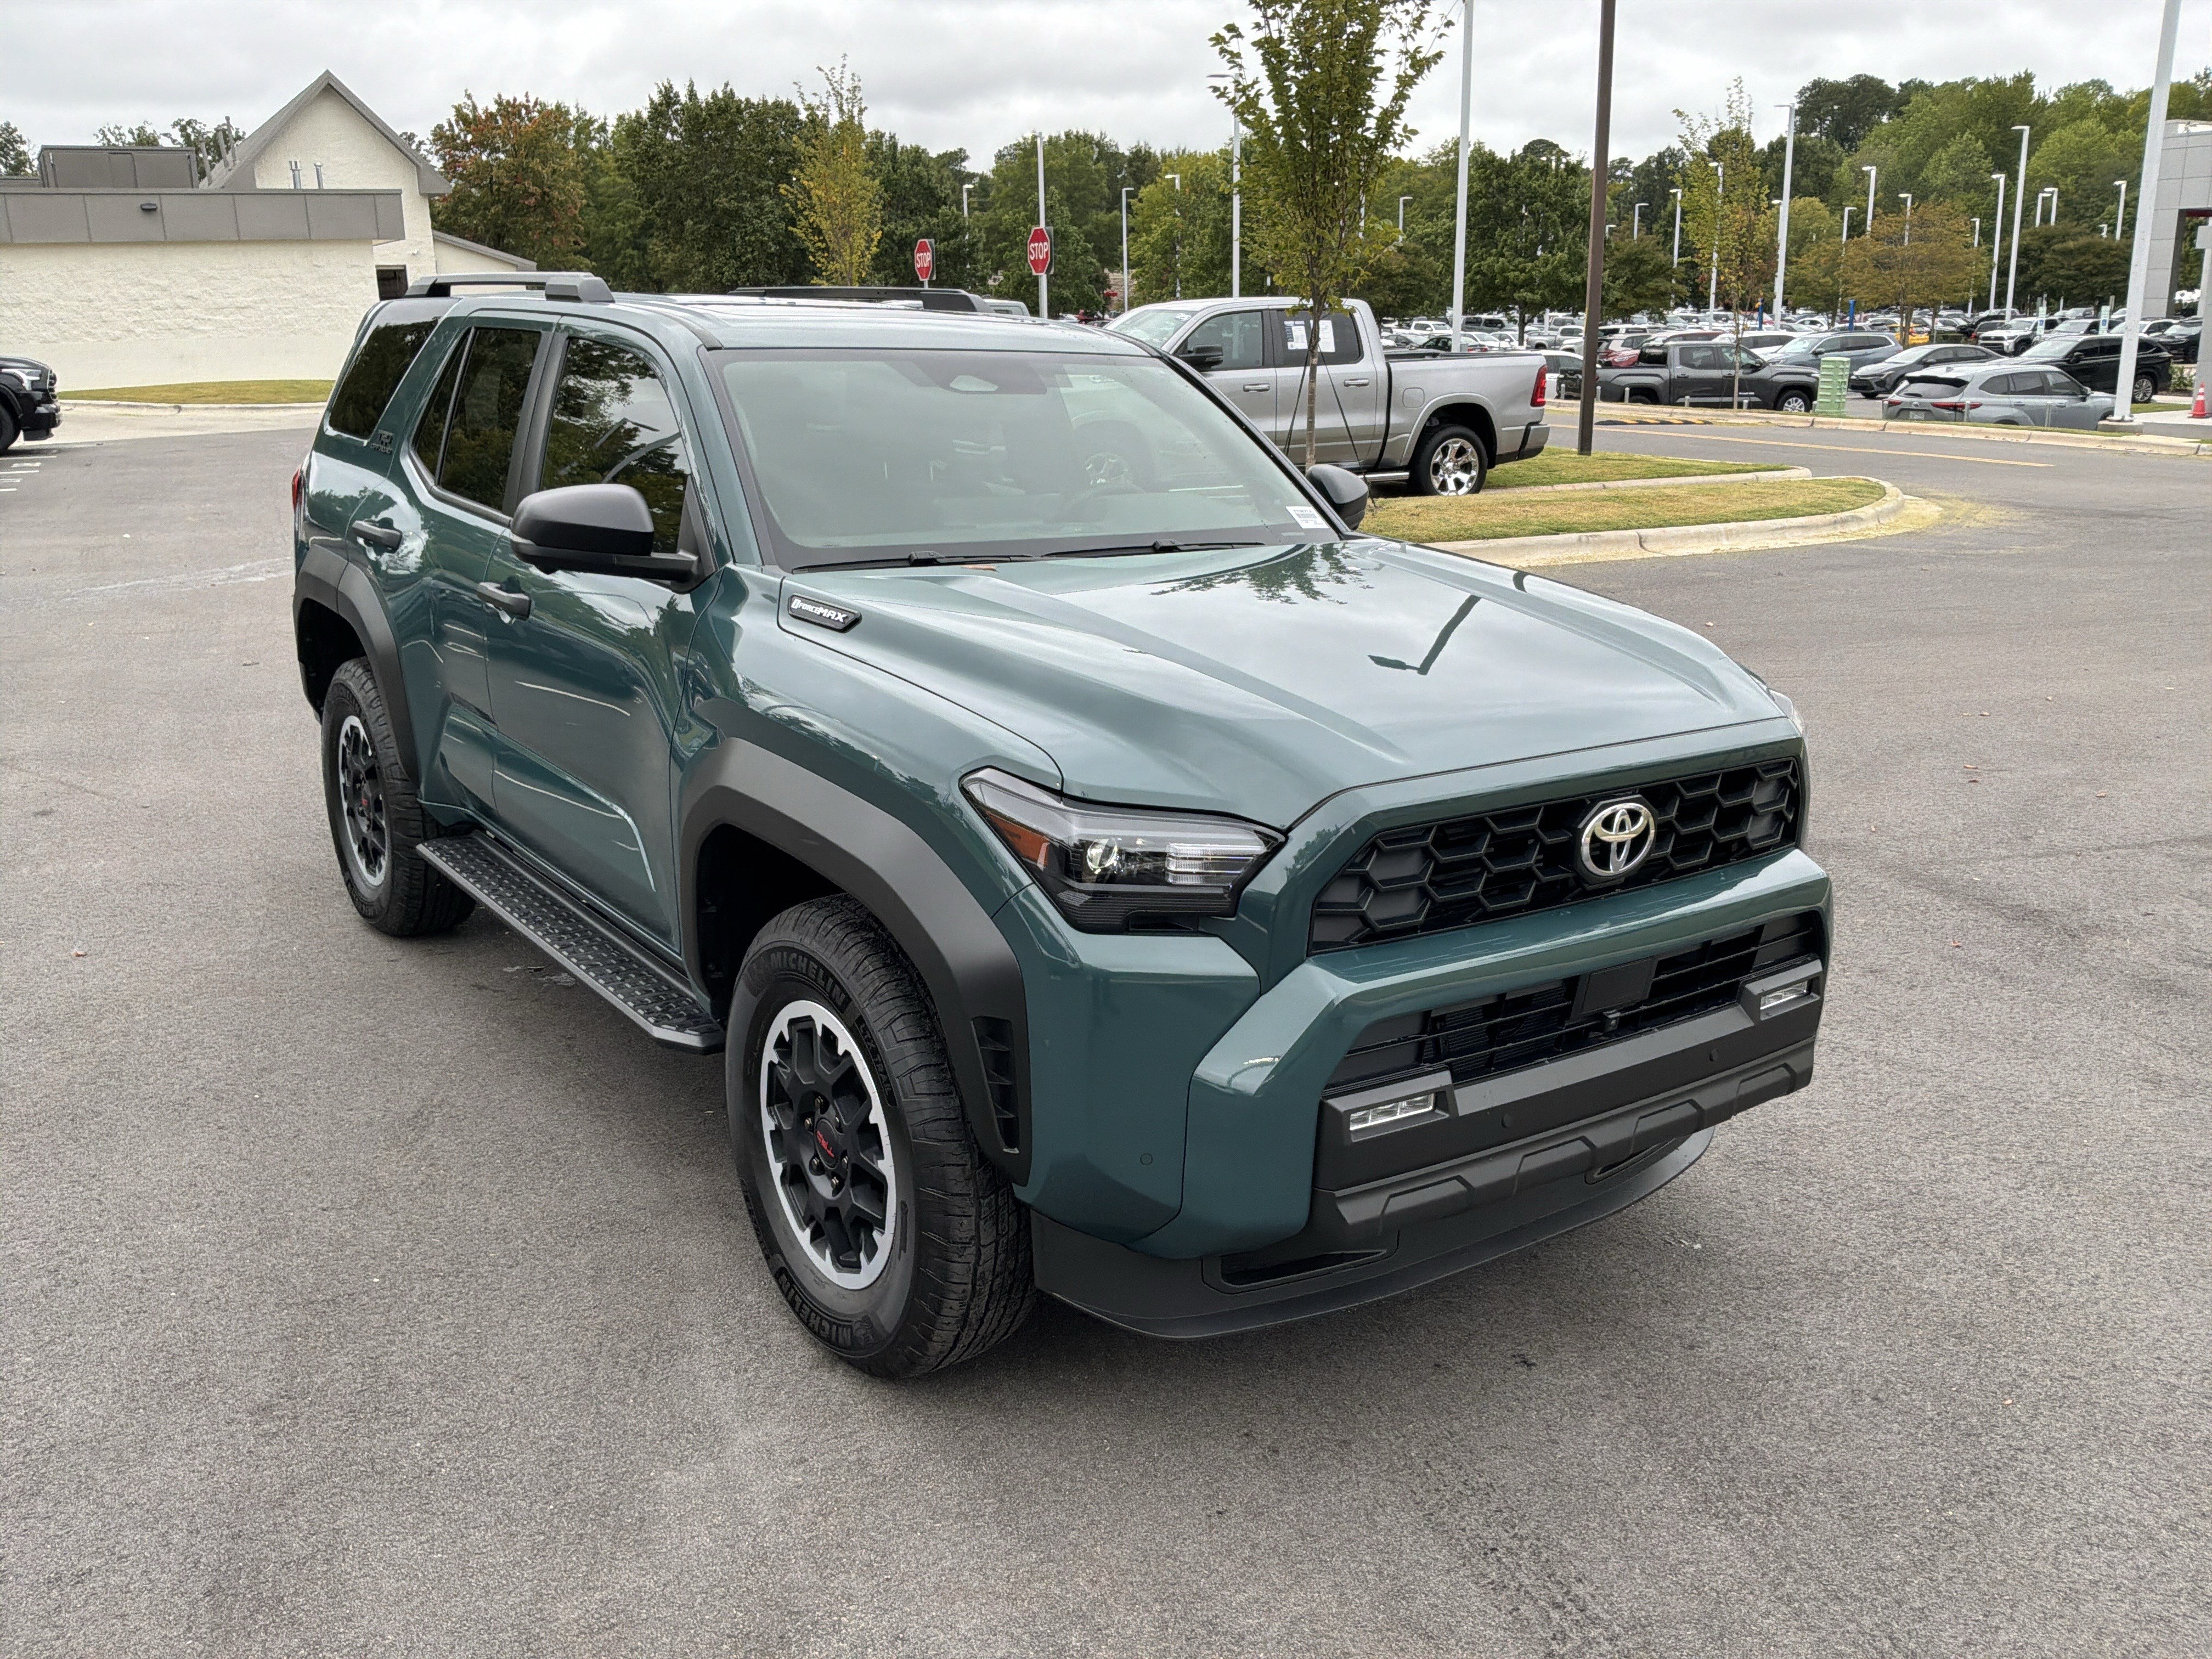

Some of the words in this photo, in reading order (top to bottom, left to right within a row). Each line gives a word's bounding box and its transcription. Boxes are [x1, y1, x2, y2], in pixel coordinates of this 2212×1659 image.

[916, 252, 930, 268] STOP
[1029, 241, 1048, 261] STOP
[770, 951, 846, 1006] MICHELIN
[777, 1273, 852, 1346] MICHELIN
